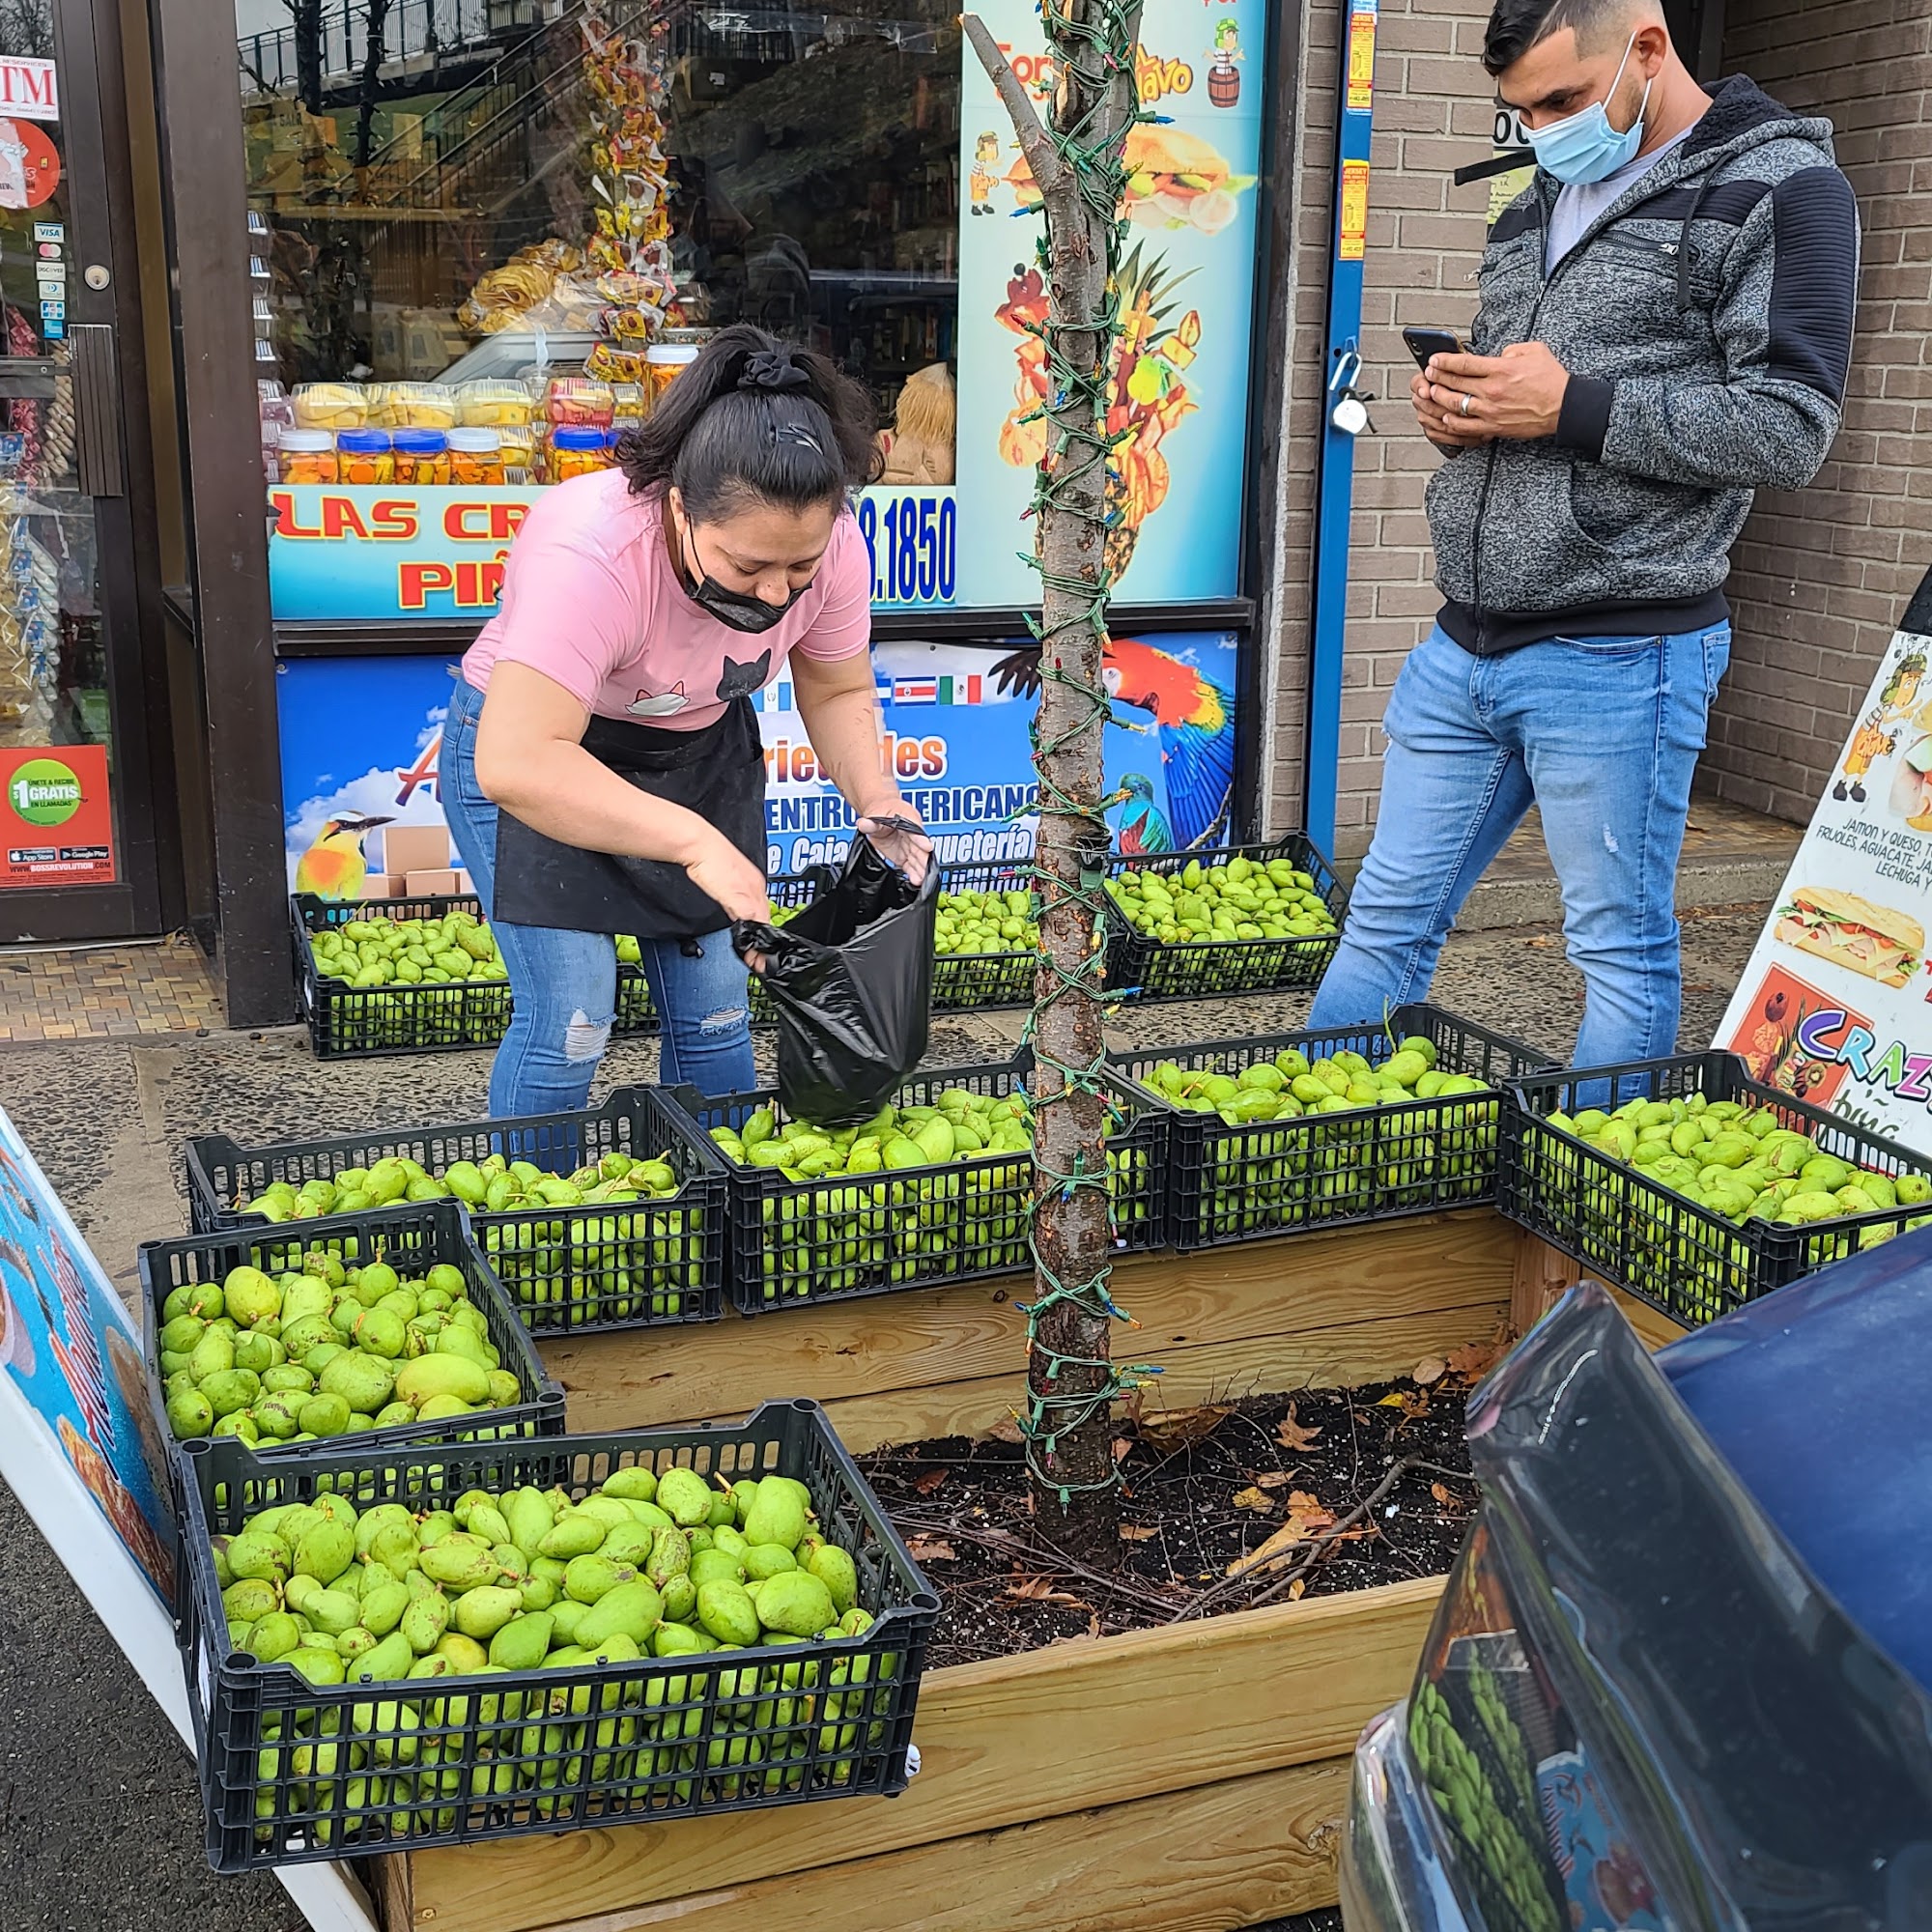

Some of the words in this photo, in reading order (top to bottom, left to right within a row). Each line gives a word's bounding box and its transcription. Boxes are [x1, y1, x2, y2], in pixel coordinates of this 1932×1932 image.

[0, 65, 55, 106] TM
[39, 228, 60, 238] VISA
[271, 492, 417, 541] LAS
[442, 502, 530, 541] CR
[849, 497, 956, 600] 8.1850
[29, 785, 79, 801] GRATIS
[1816, 825, 1858, 851] FRIJOLES,
[1859, 839, 1915, 869] AGUACATE,
[1881, 829, 1890, 842] Y
[1889, 832, 1922, 856] QUESO,
[1875, 861, 1920, 887] LECHUGA
[1798, 1009, 1932, 1104] CRAZ
